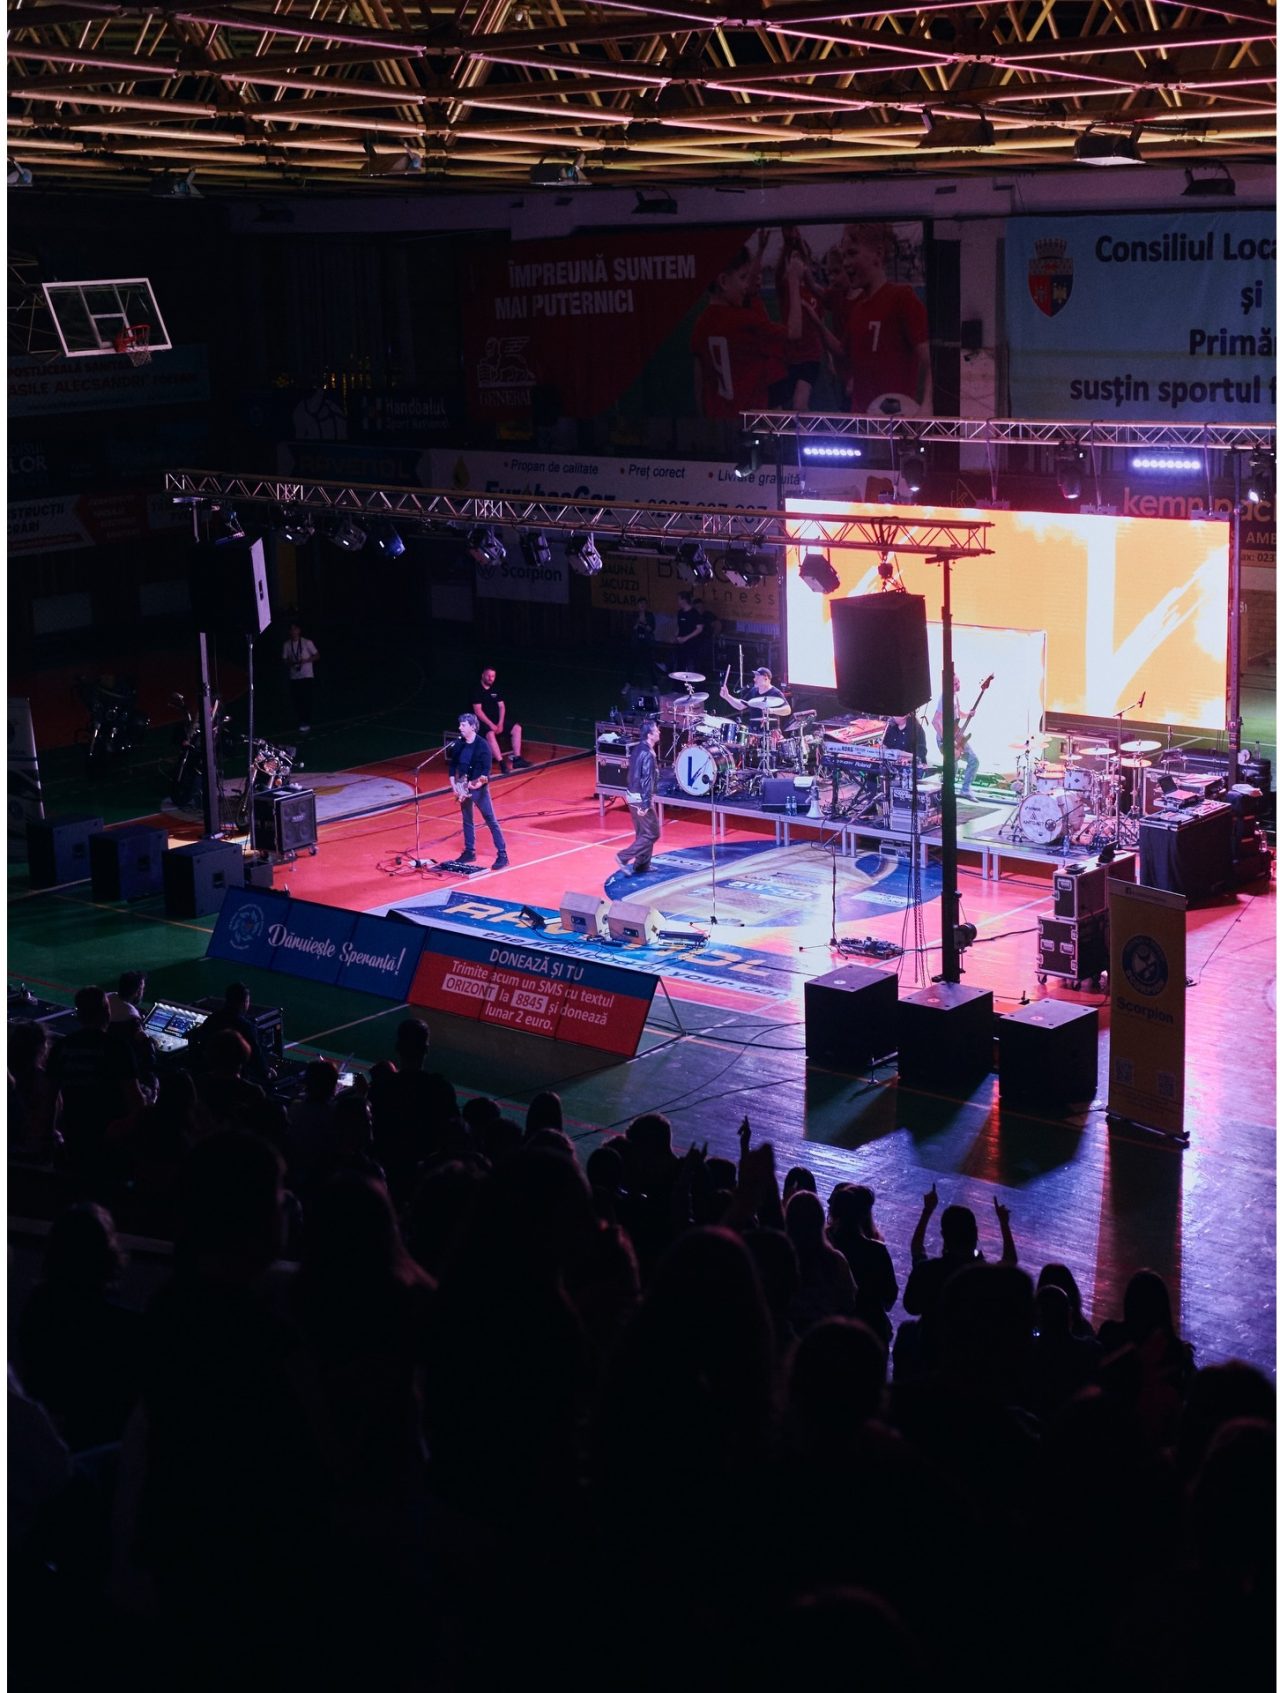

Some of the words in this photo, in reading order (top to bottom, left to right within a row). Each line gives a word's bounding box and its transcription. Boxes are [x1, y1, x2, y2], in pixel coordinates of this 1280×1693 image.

[1095, 232, 1214, 262] Consiliul
[507, 254, 608, 288] ÎMPREUNĂ
[614, 254, 696, 283] SUNTEM
[495, 297, 531, 320] MAI
[534, 289, 634, 317] PUTERNICI
[1241, 280, 1263, 315] și
[1070, 374, 1149, 408] susțin
[1158, 375, 1261, 409] sportul
[511, 459, 545, 473] Propan
[548, 462, 560, 473] de
[563, 462, 599, 475] calitate
[653, 467, 685, 479] corect
[758, 473, 801, 487] grauită
[501, 564, 562, 584] Scorpion
[268, 923, 336, 960] Dăruiește
[339, 942, 407, 976] Speranță!
[482, 930, 526, 945] the
[668, 970, 734, 986] your
[739, 984, 790, 998] car
[489, 949, 549, 974] DONEAZĂ
[551, 962, 564, 979] ȘI
[566, 965, 584, 981] TU
[452, 960, 488, 979] Trimite
[491, 972, 520, 987] acum
[521, 980, 536, 991] un
[538, 981, 564, 997] SMS
[565, 988, 579, 999] cu
[581, 991, 615, 1008] textul
[446, 977, 496, 998] ORIZONT
[499, 989, 509, 1002] la
[515, 993, 544, 1010] 8845
[548, 1000, 558, 1016] și
[561, 1003, 608, 1026] donează
[485, 1002, 513, 1021] lunar
[515, 1010, 522, 1022] 2
[524, 1015, 553, 1031] euro.
[1116, 996, 1174, 1024] Scorpion
